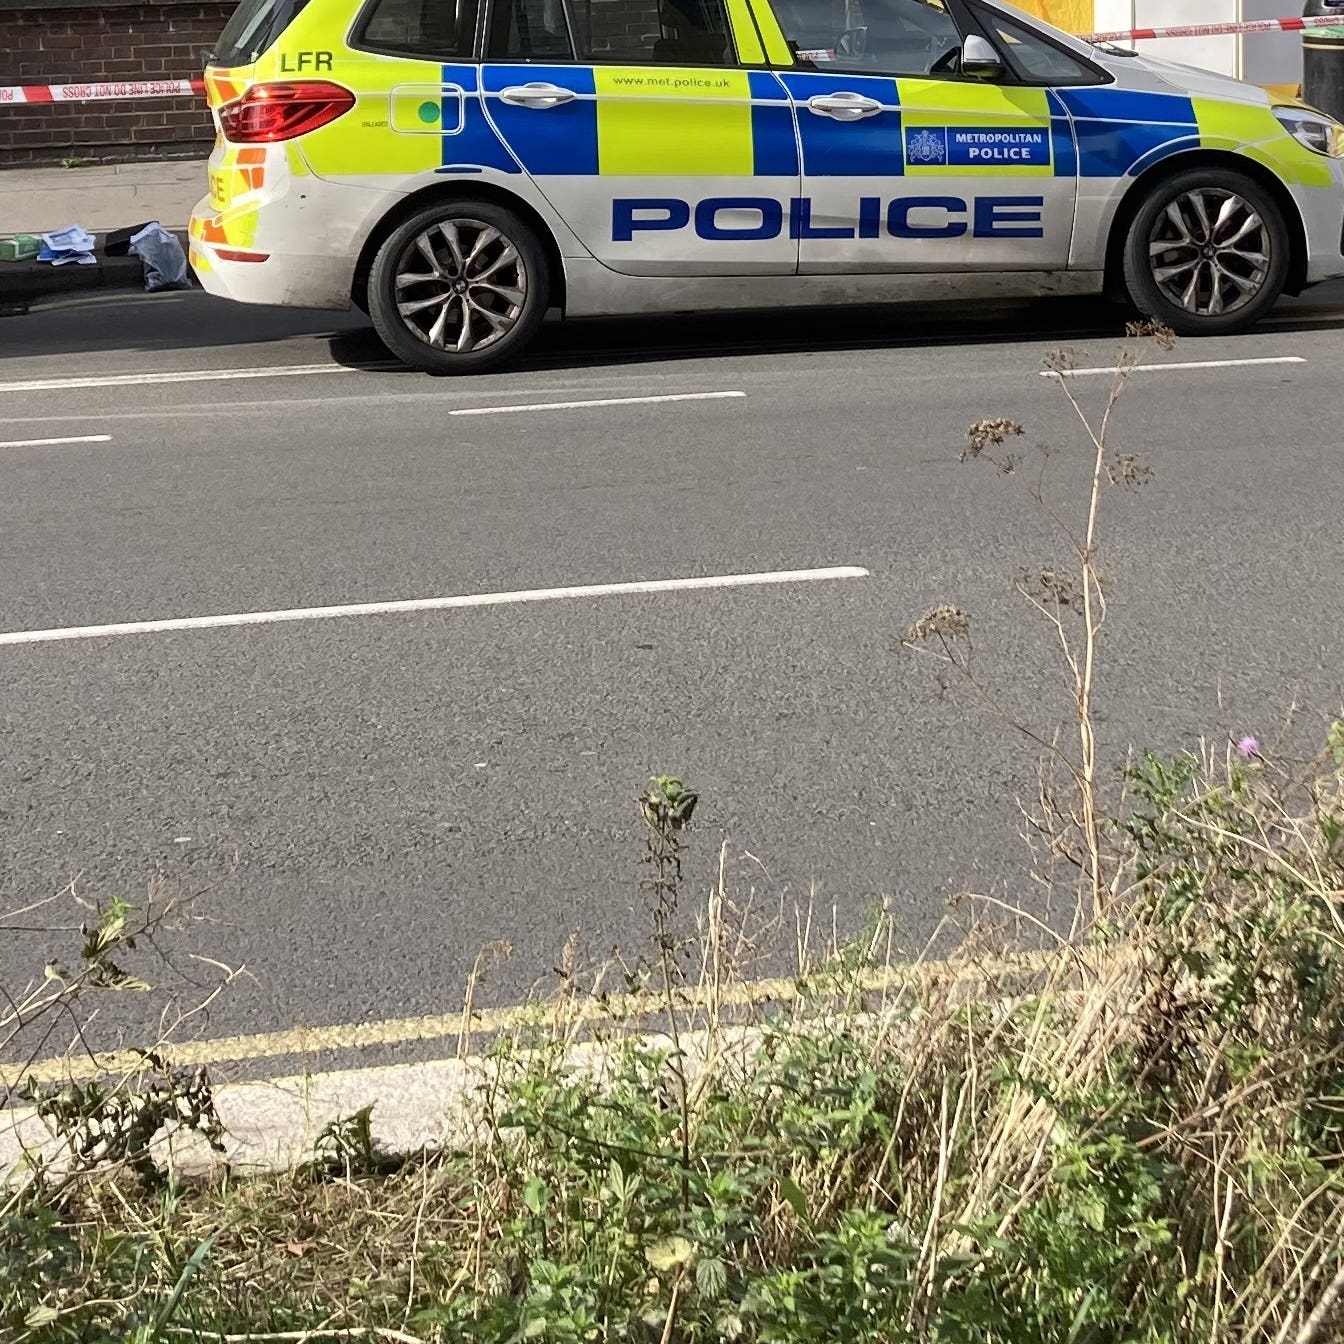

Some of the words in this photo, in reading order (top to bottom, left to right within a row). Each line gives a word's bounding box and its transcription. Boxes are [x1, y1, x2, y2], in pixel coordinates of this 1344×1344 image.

[280, 51, 333, 73] LFR
[613, 77, 729, 88] www.met.police.uk
[62, 86, 91, 98] CROSS
[956, 133, 1042, 143] METROPOLITAN
[968, 147, 1031, 159] POLICE
[612, 196, 1044, 241] POLICE
